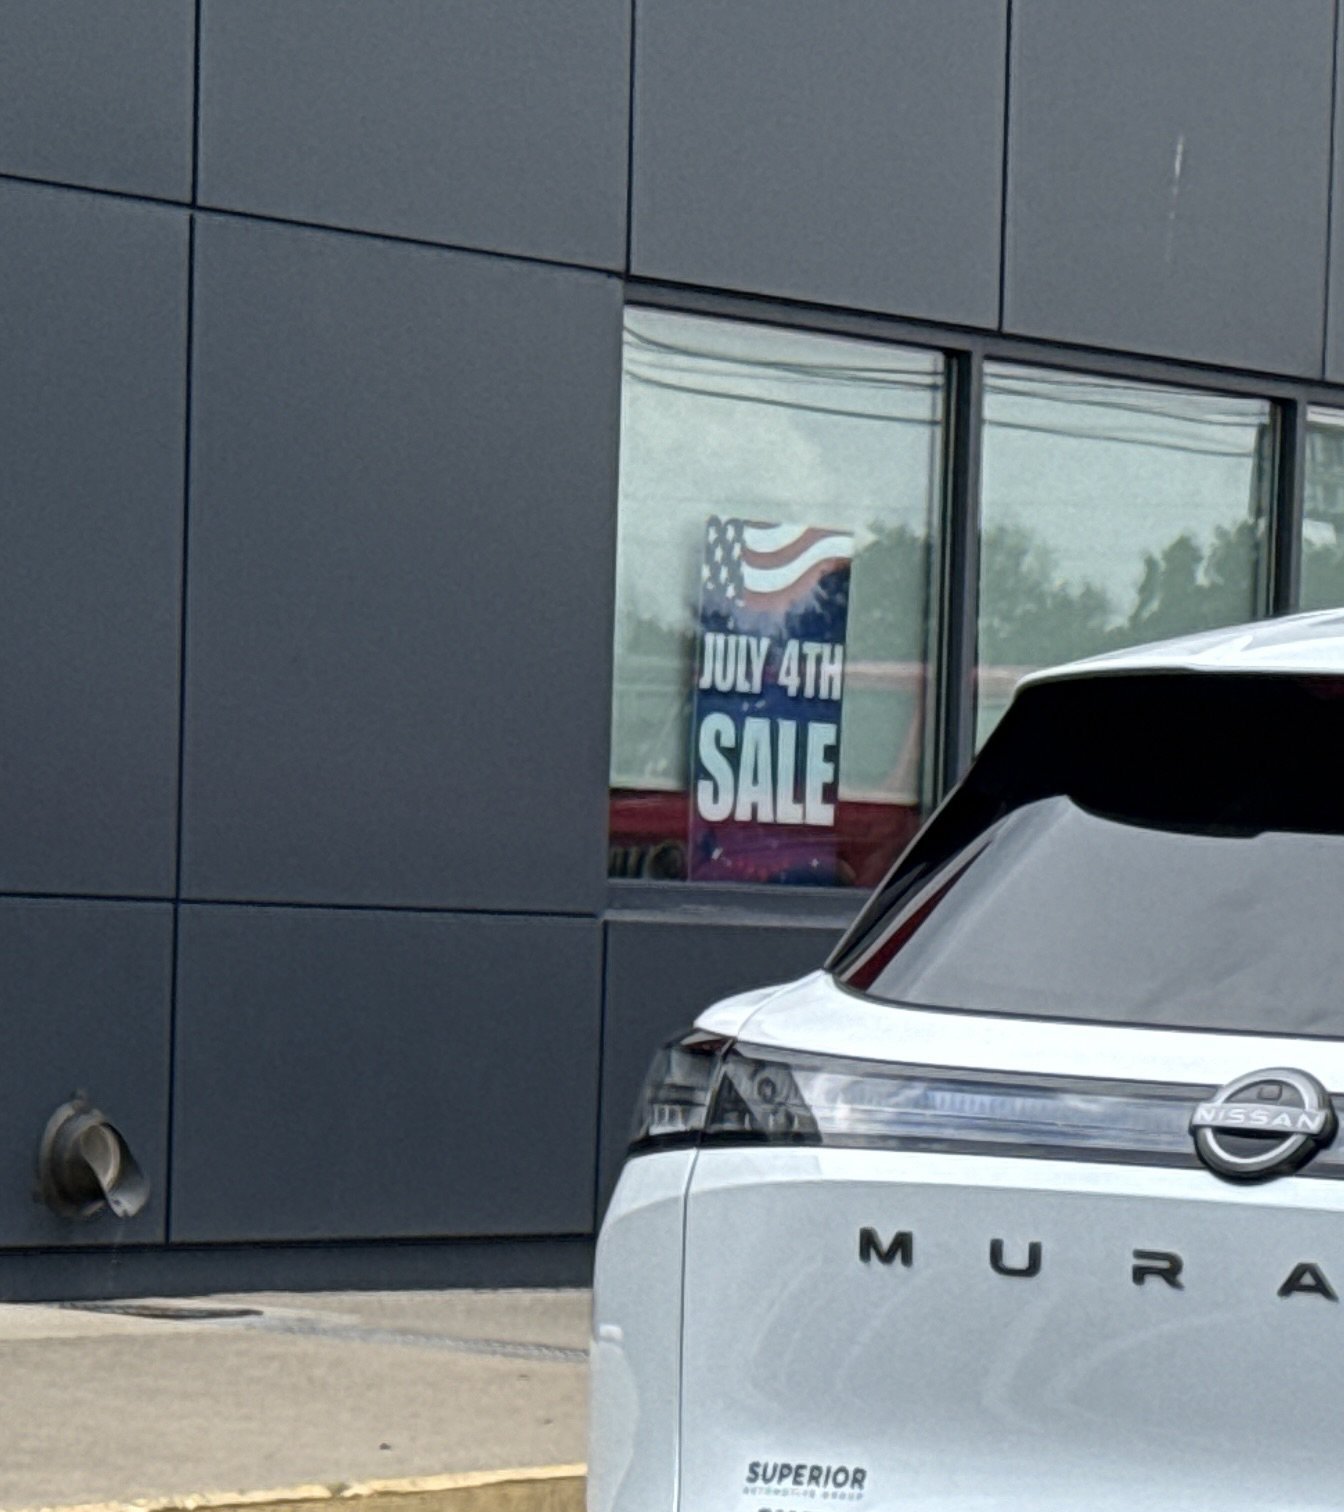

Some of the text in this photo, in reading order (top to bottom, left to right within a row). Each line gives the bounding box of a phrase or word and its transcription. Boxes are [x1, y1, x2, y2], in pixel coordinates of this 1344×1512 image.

[700, 632, 844, 701] JULY 4TH
[697, 712, 837, 827] SALE
[1197, 1107, 1324, 1132] NISSAN
[745, 1461, 868, 1491] SUPERIOR
